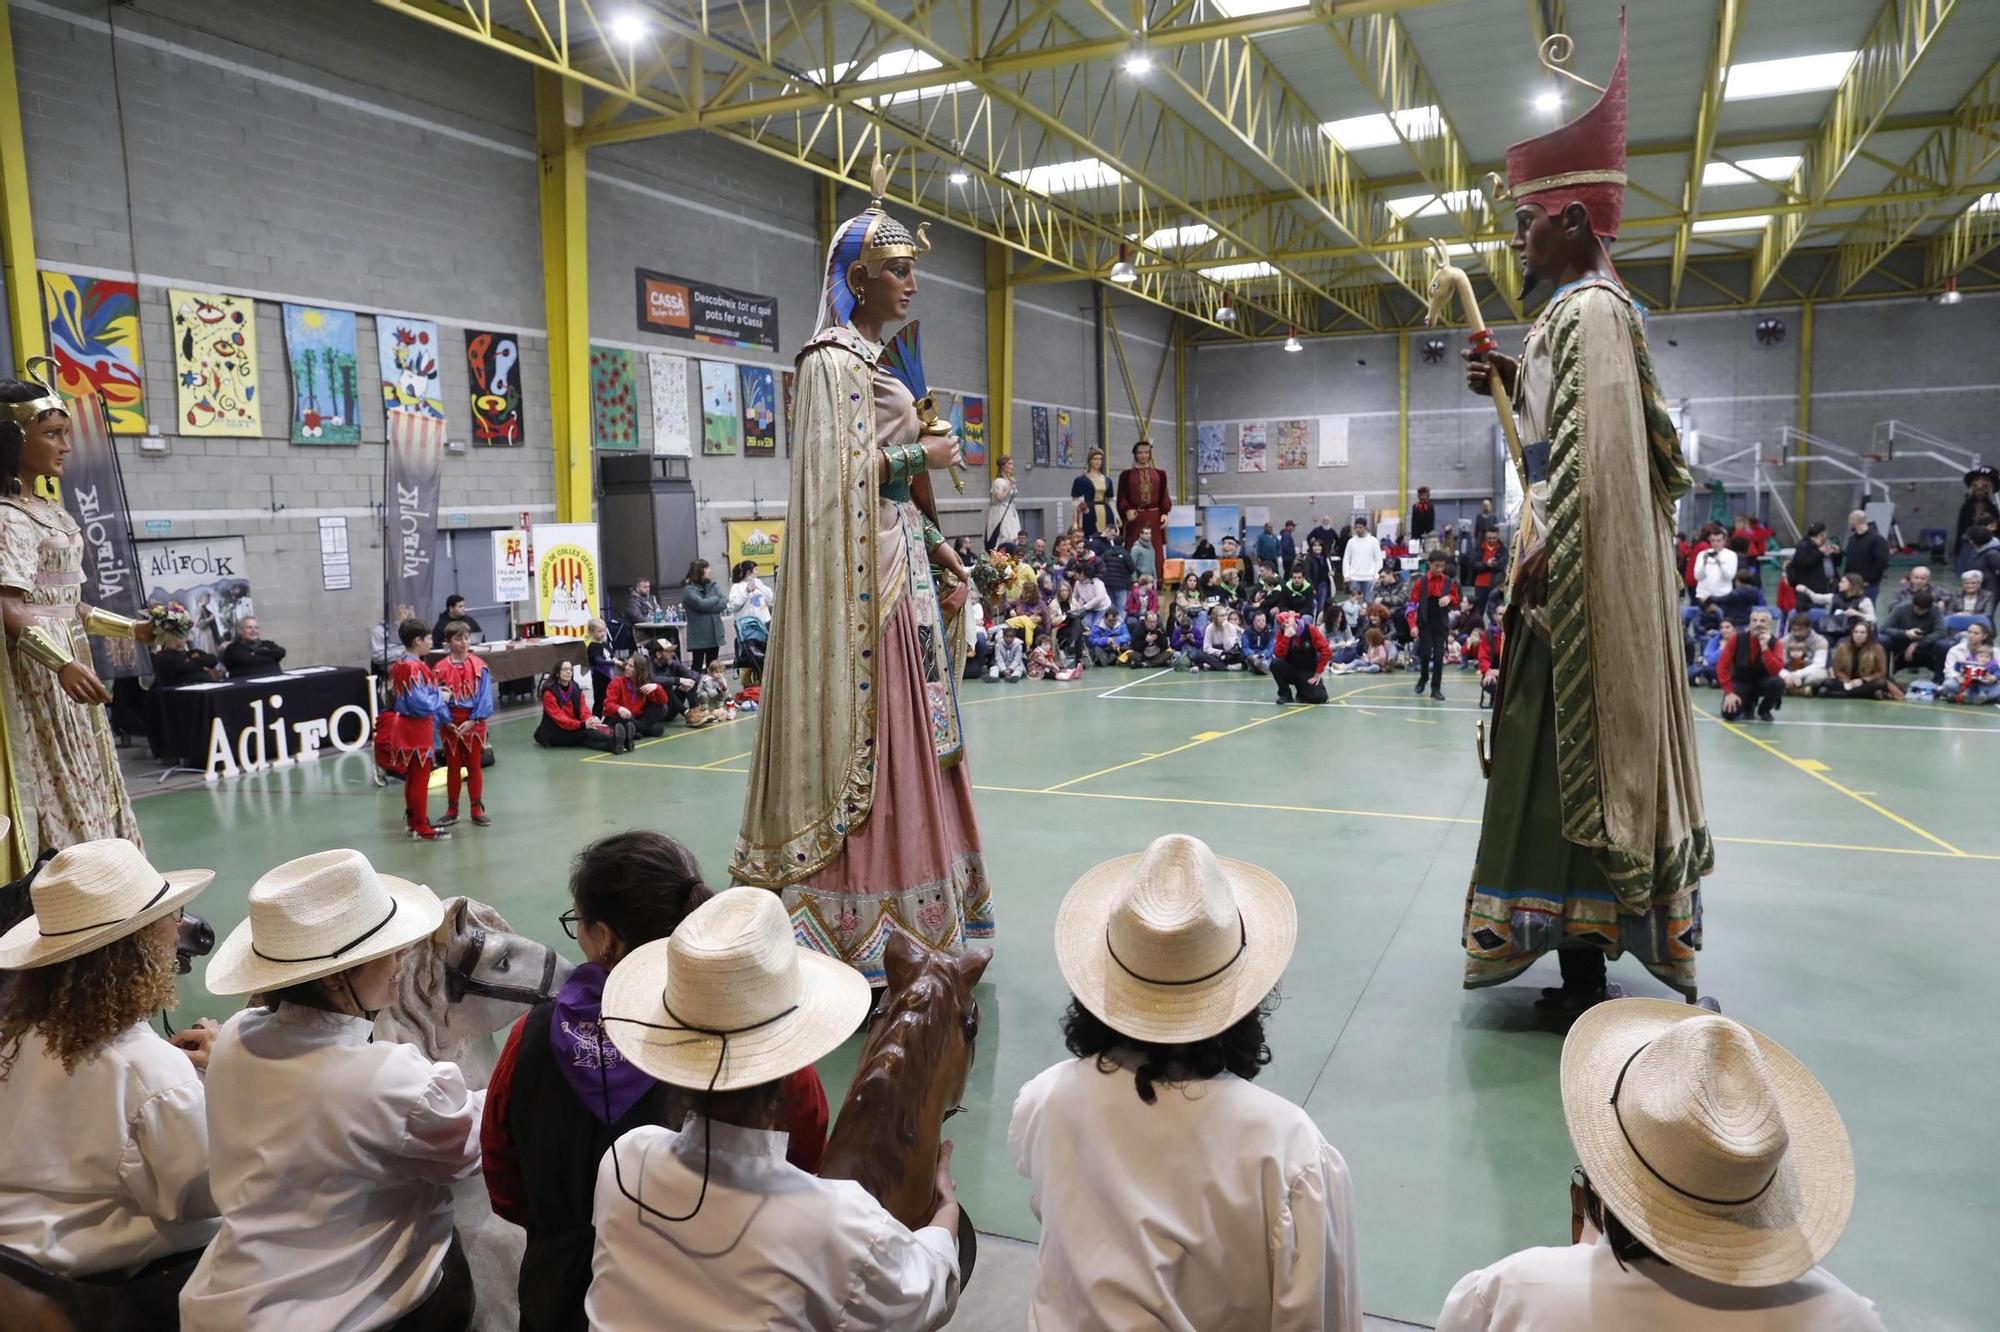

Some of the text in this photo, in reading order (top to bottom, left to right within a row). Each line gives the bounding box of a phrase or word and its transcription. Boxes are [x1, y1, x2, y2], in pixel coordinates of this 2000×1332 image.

[650, 291, 685, 310] CASSÀ
[694, 291, 772, 316] Descobreix tot el que
[705, 309, 723, 321] pots
[724, 311, 735, 323] fer
[743, 315, 763, 328] Cassà
[548, 553, 556, 562] DE
[557, 548, 580, 557] COLLES
